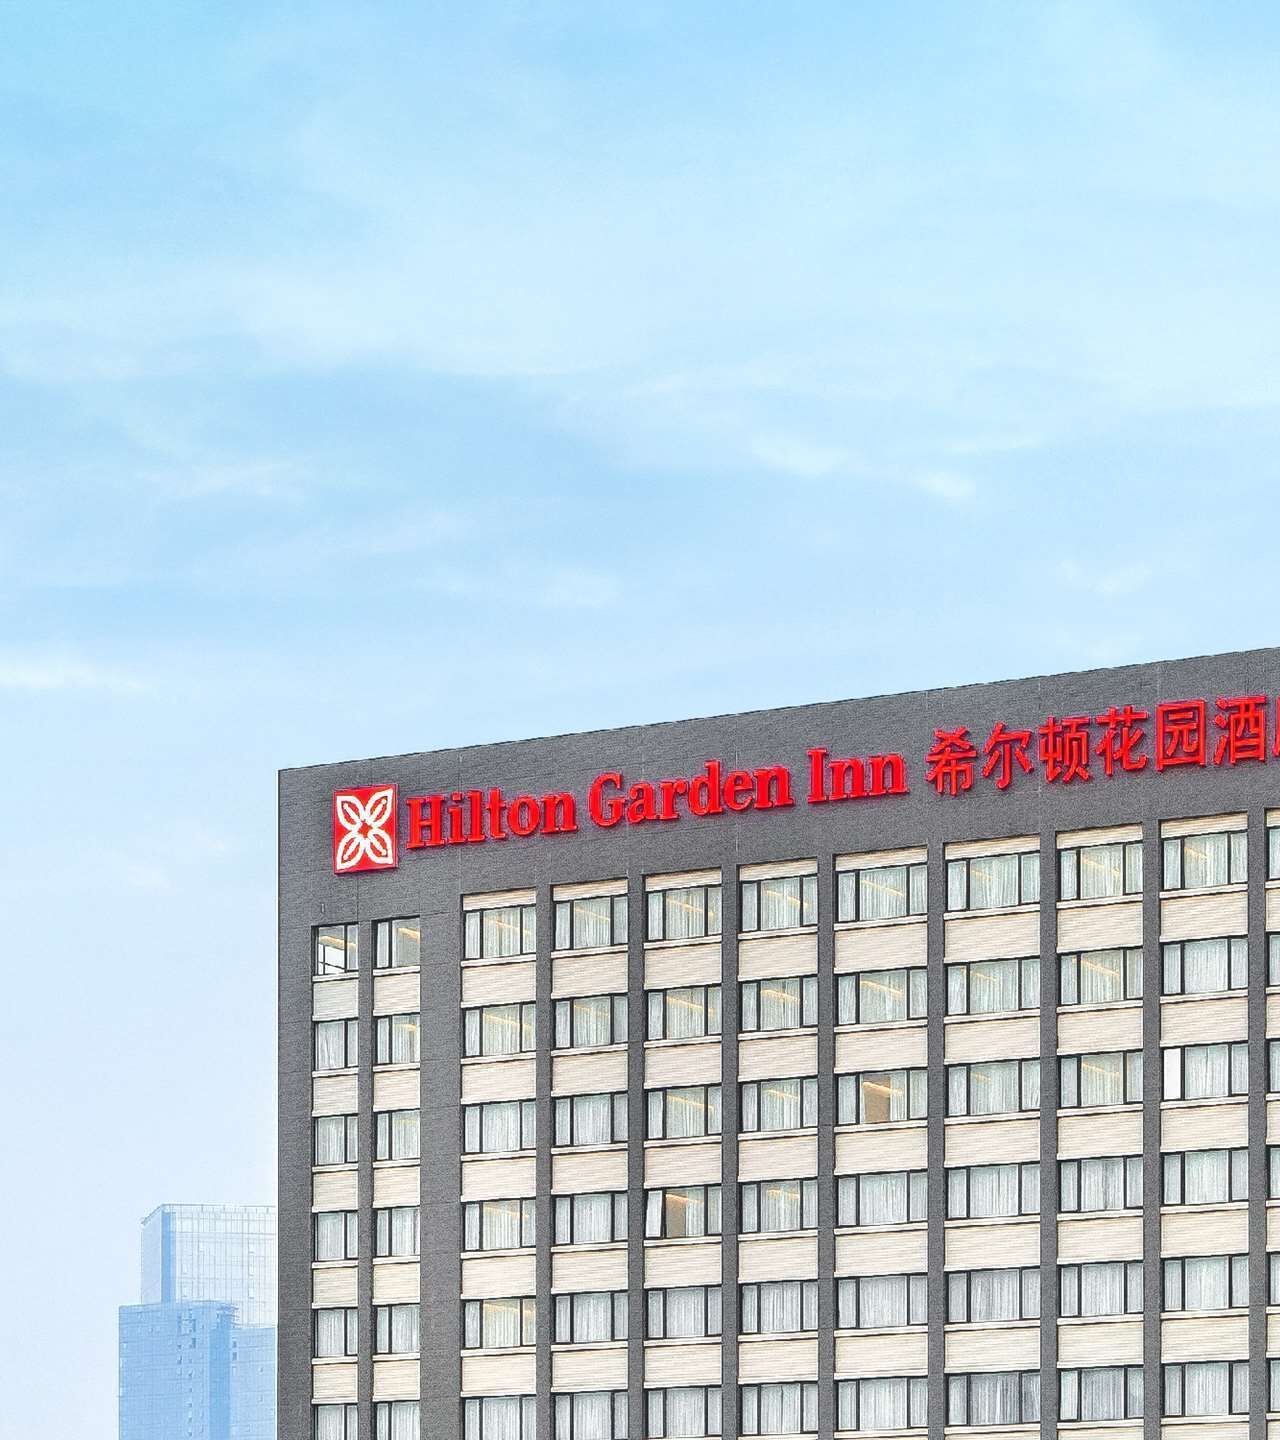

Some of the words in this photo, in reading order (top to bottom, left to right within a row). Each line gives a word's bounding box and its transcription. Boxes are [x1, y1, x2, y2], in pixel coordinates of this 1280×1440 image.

[405, 786, 578, 850] Hilton
[586, 759, 795, 827] Garden
[806, 746, 909, 803] Inn
